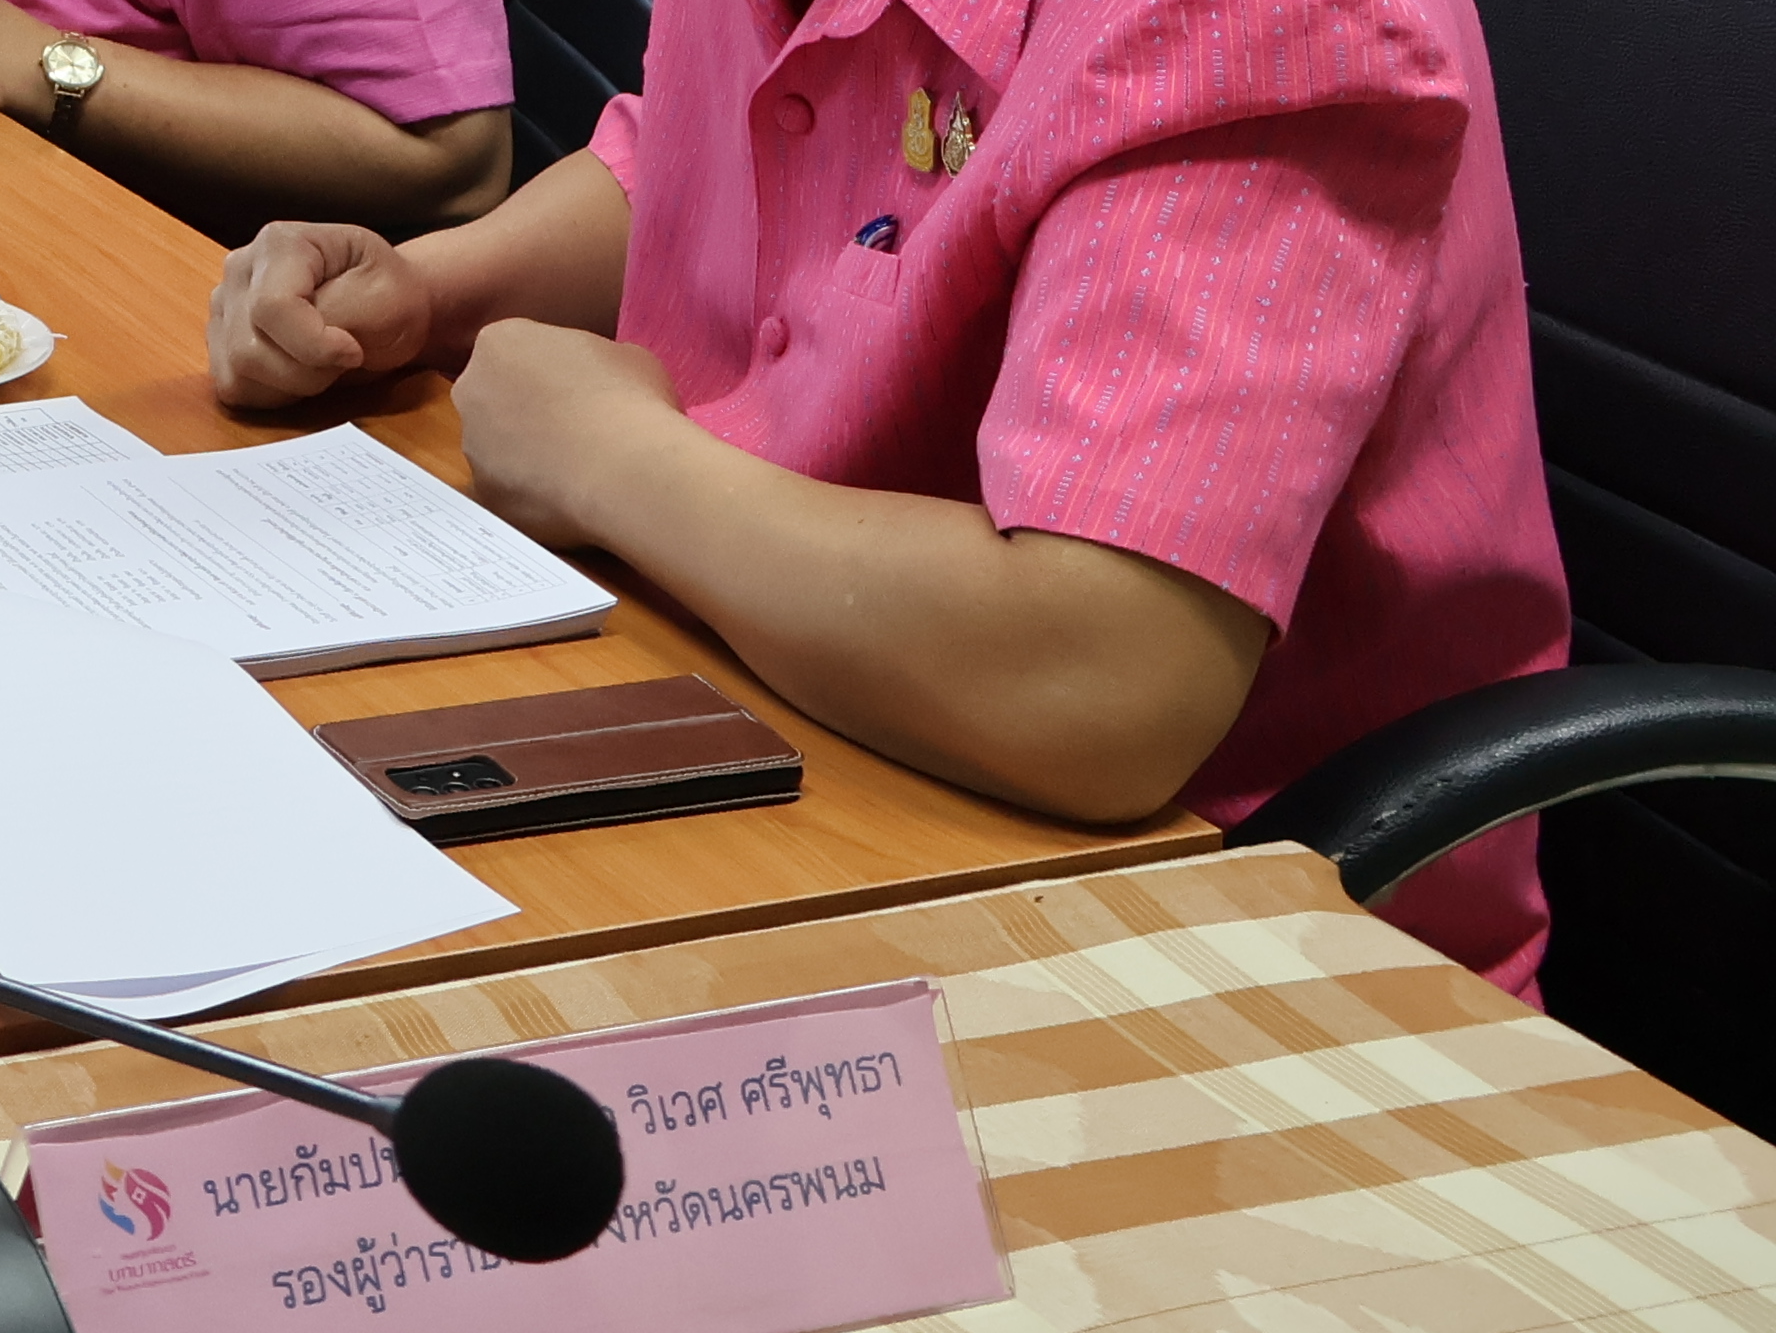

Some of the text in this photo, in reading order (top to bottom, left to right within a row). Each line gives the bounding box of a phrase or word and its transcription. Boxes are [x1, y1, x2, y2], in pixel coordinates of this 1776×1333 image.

[627, 1072, 726, 1137] วิเวศ
[740, 1048, 903, 1123] ศรีพุทธา
